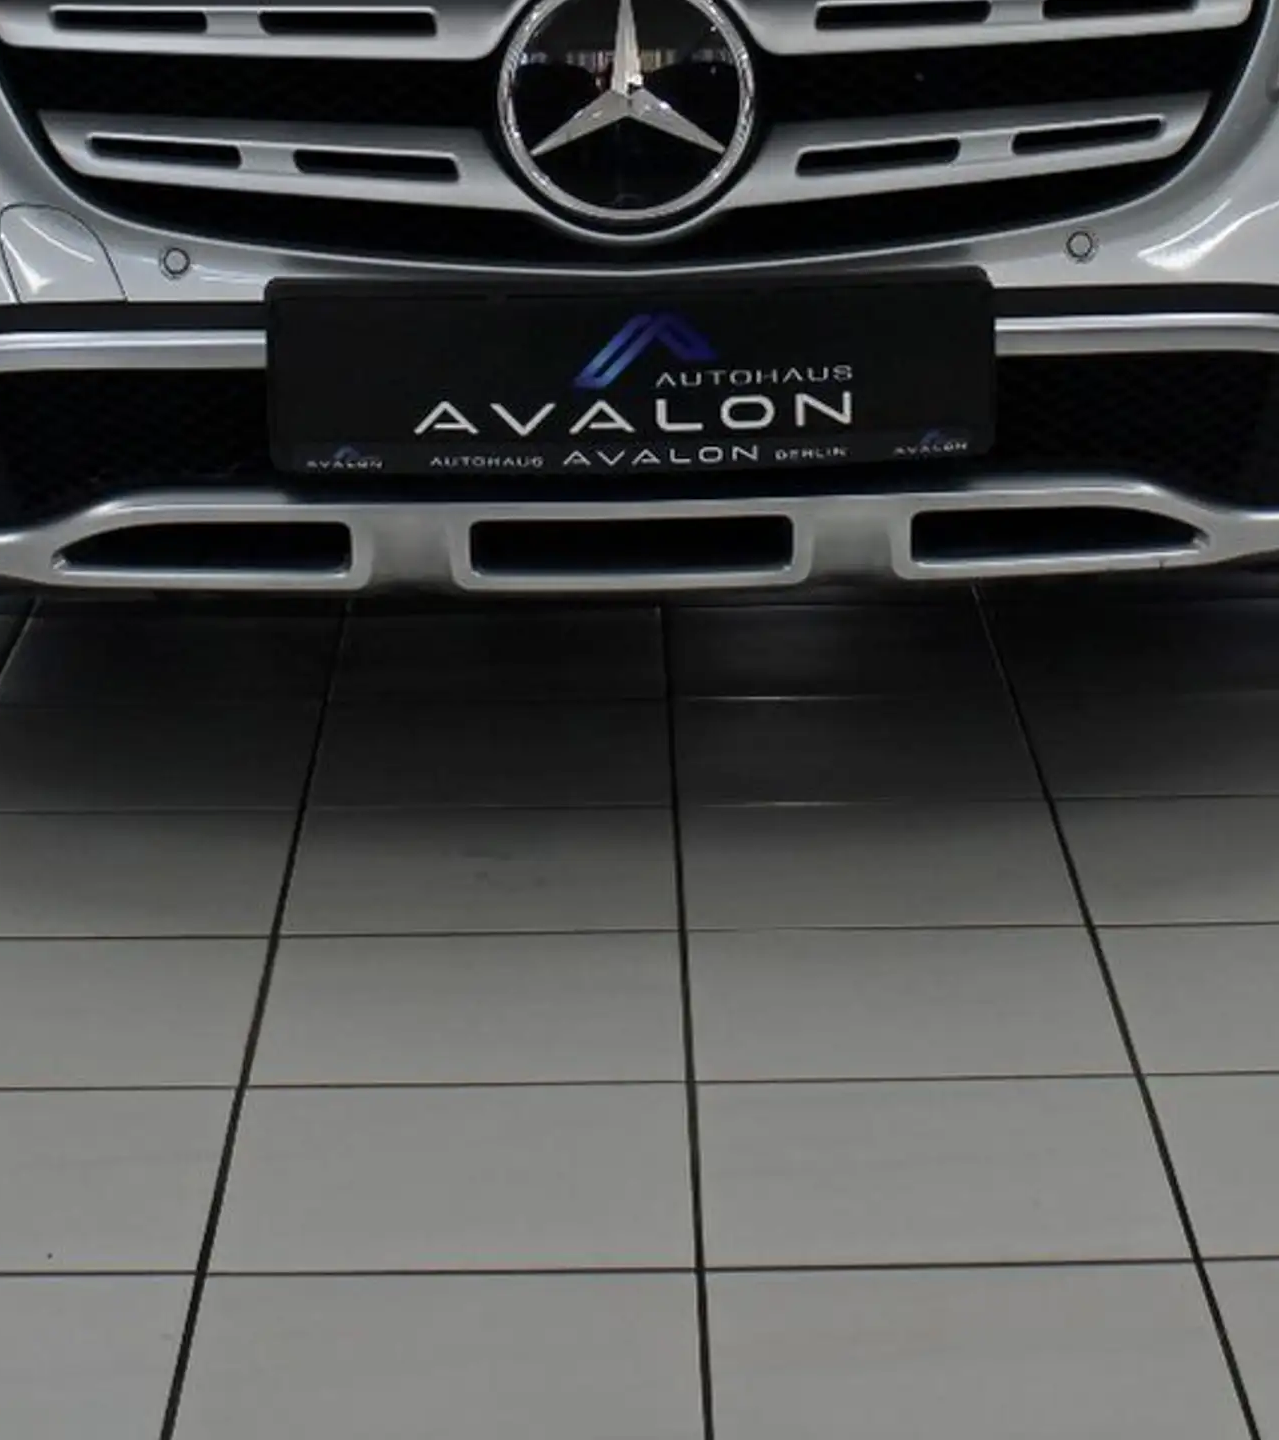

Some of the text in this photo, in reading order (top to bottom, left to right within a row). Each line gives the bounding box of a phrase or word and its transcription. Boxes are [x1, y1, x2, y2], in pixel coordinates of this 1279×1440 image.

[654, 364, 854, 388] AUTOHAUS
[413, 390, 853, 437] AVALON
[430, 455, 544, 469] AUTOHAUS
[563, 444, 759, 467] AVALON
